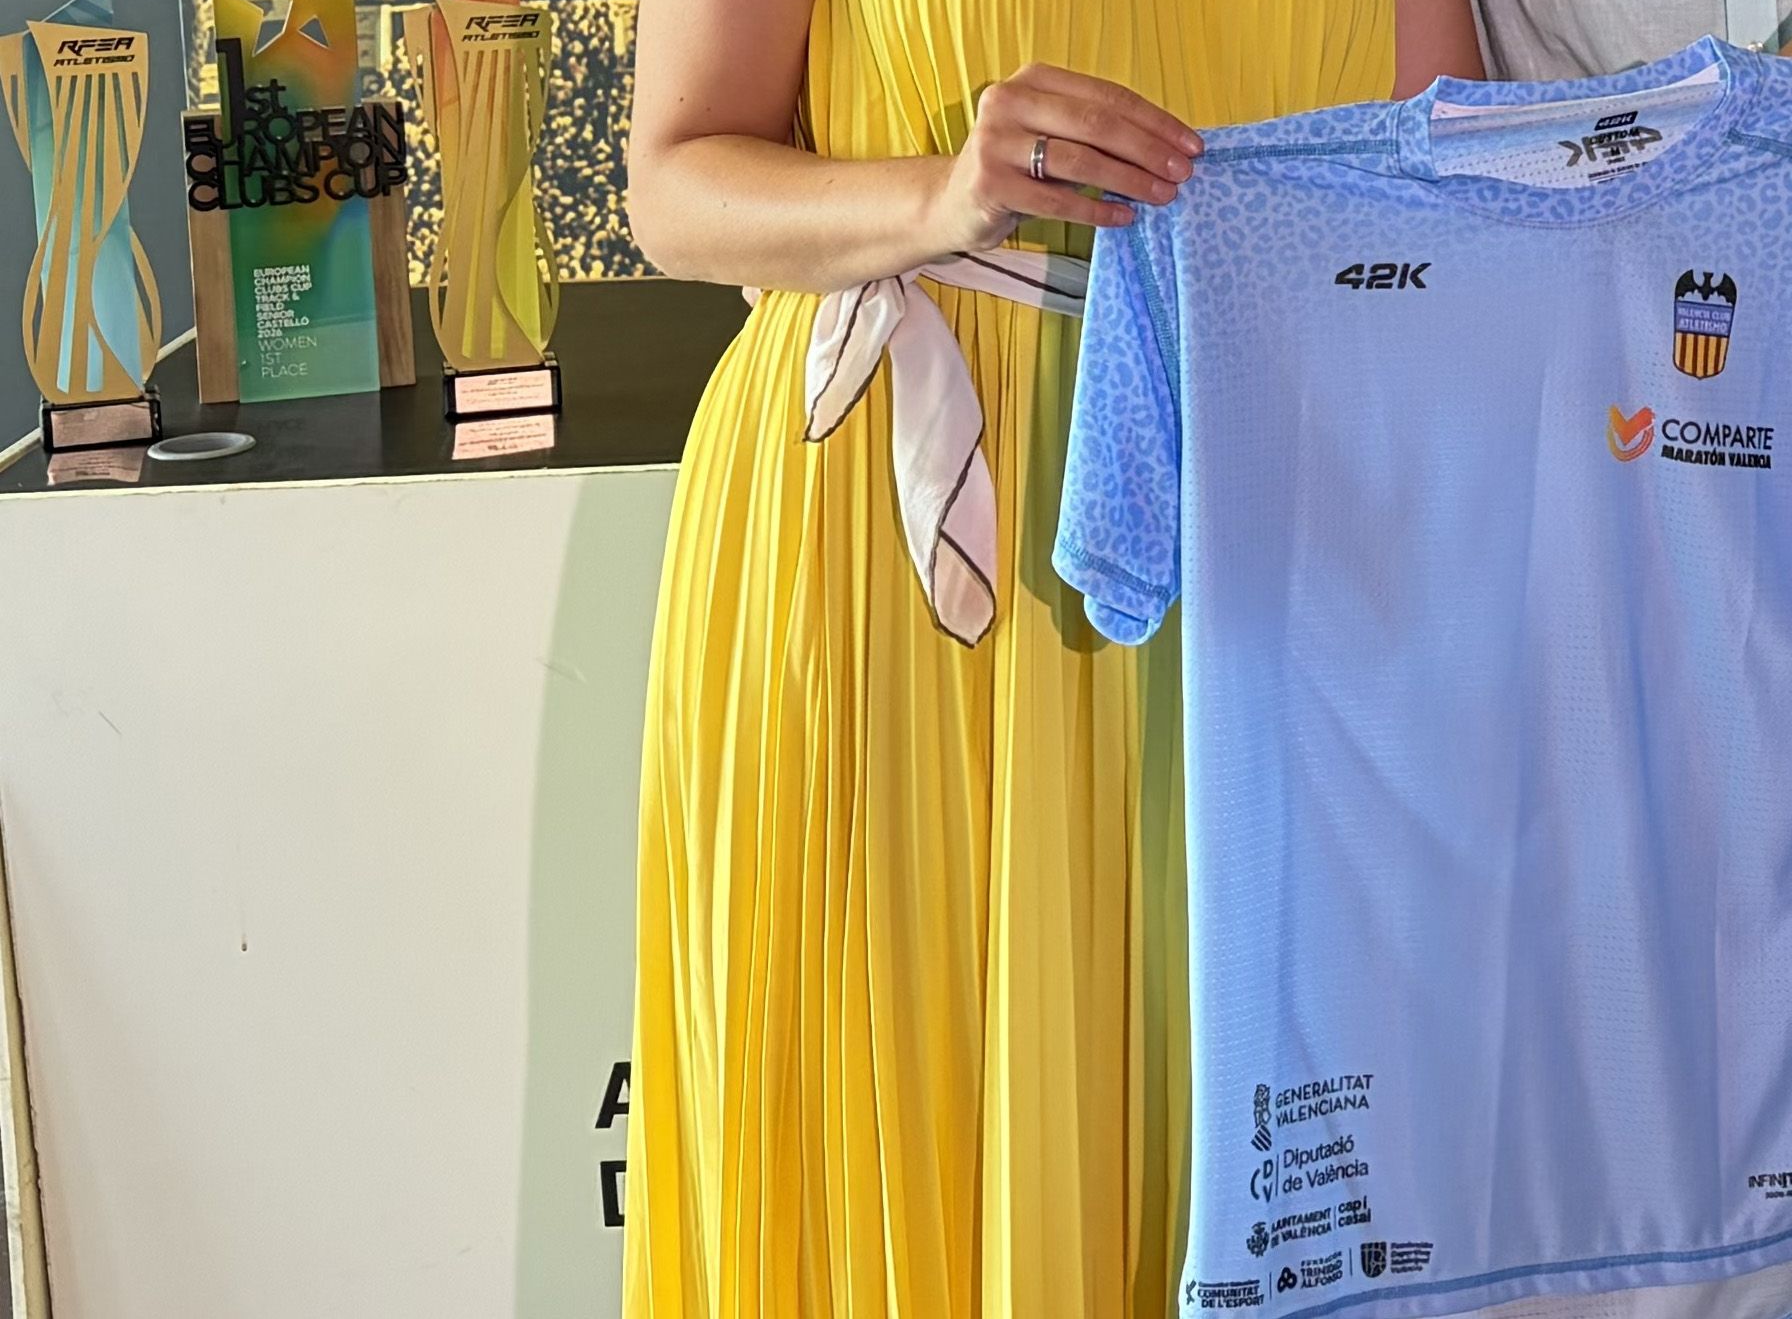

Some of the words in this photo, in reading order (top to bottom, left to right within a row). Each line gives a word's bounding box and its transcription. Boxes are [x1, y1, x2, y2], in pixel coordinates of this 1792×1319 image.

[466, 13, 539, 32] RFEA
[57, 37, 135, 56] RFEA
[184, 101, 405, 152] EUROPEAN
[185, 135, 407, 181] CHAMPION
[188, 174, 320, 212] CLUBS
[323, 164, 408, 201] CUP
[253, 265, 310, 278] EUROPEAN
[1334, 262, 1433, 290] 42K
[1678, 318, 1729, 332] ATLETISMO
[258, 336, 318, 351] WOMEN
[261, 352, 282, 365] 1ST
[262, 362, 309, 378] PLACE
[1661, 418, 1775, 450] COMPARTE
[1661, 444, 1726, 466] MARATÓN
[1729, 452, 1771, 469] VALENCIA
[1275, 1074, 1374, 1109] GENERALITAT
[1276, 1094, 1370, 1128] VALENCIANA
[1283, 1134, 1355, 1169] Diputació
[1282, 1174, 1303, 1194] de
[1306, 1159, 1369, 1188] València
